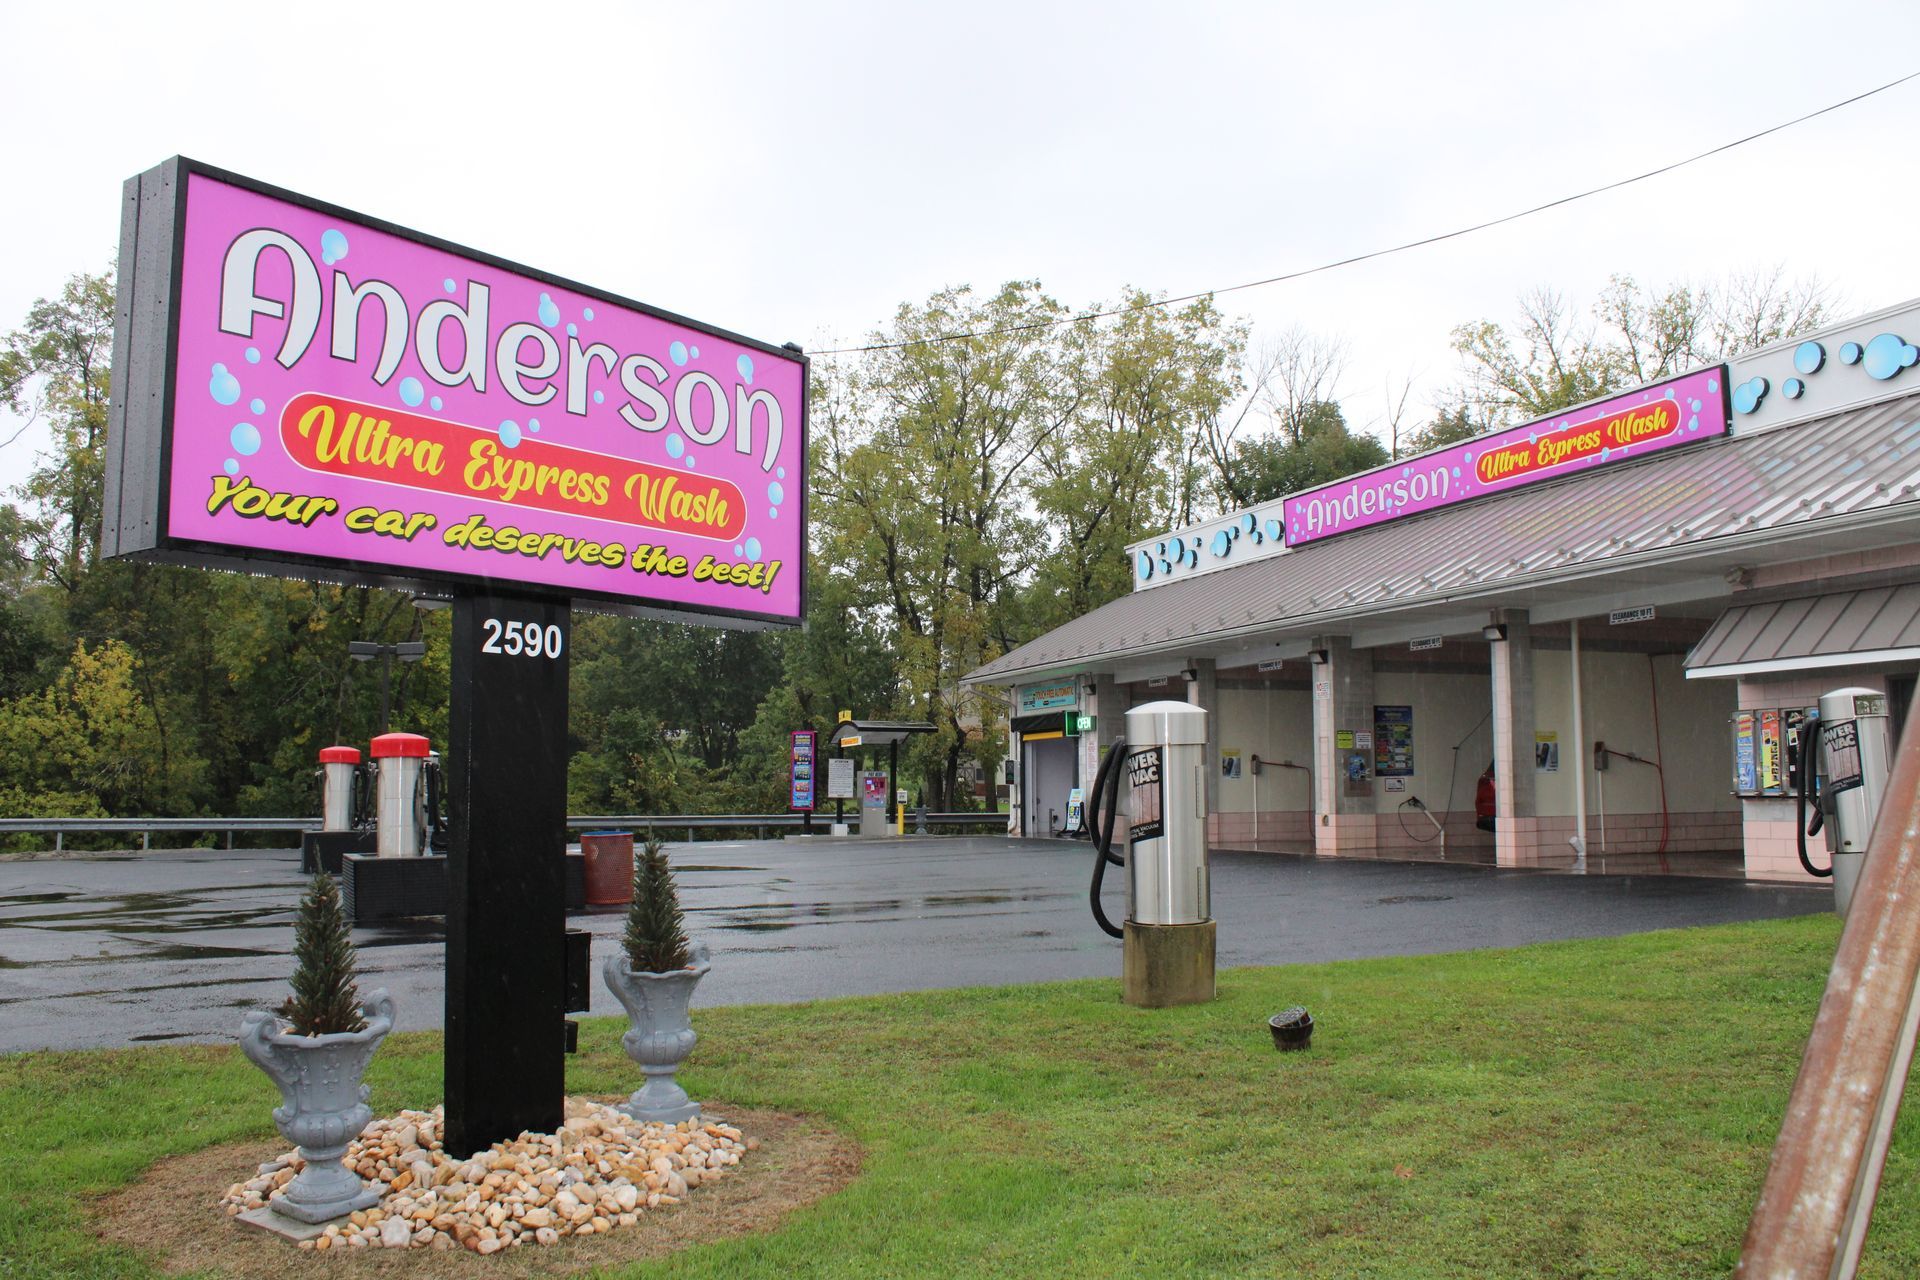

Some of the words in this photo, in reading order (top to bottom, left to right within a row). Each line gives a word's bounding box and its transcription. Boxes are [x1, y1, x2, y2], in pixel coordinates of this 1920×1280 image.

[218, 227, 784, 473] Anderson
[298, 405, 445, 476] Ultra
[464, 439, 610, 505] Express
[624, 473, 730, 528] Wash
[1481, 449, 1530, 479] Ultra
[1537, 430, 1601, 465] Express
[1607, 407, 1669, 443] Wash
[1307, 467, 1449, 534] Anderson
[206, 475, 339, 527] Your
[344, 506, 438, 542] car
[442, 514, 626, 567] deserves
[631, 544, 688, 576] the
[692, 555, 782, 595] best!
[482, 618, 562, 659] 2590
[1612, 610, 1639, 620] CLEARANCE
[1077, 716, 1091, 729] OPEN
[1831, 734, 1856, 751] VAC
[1133, 766, 1159, 784] VAC
